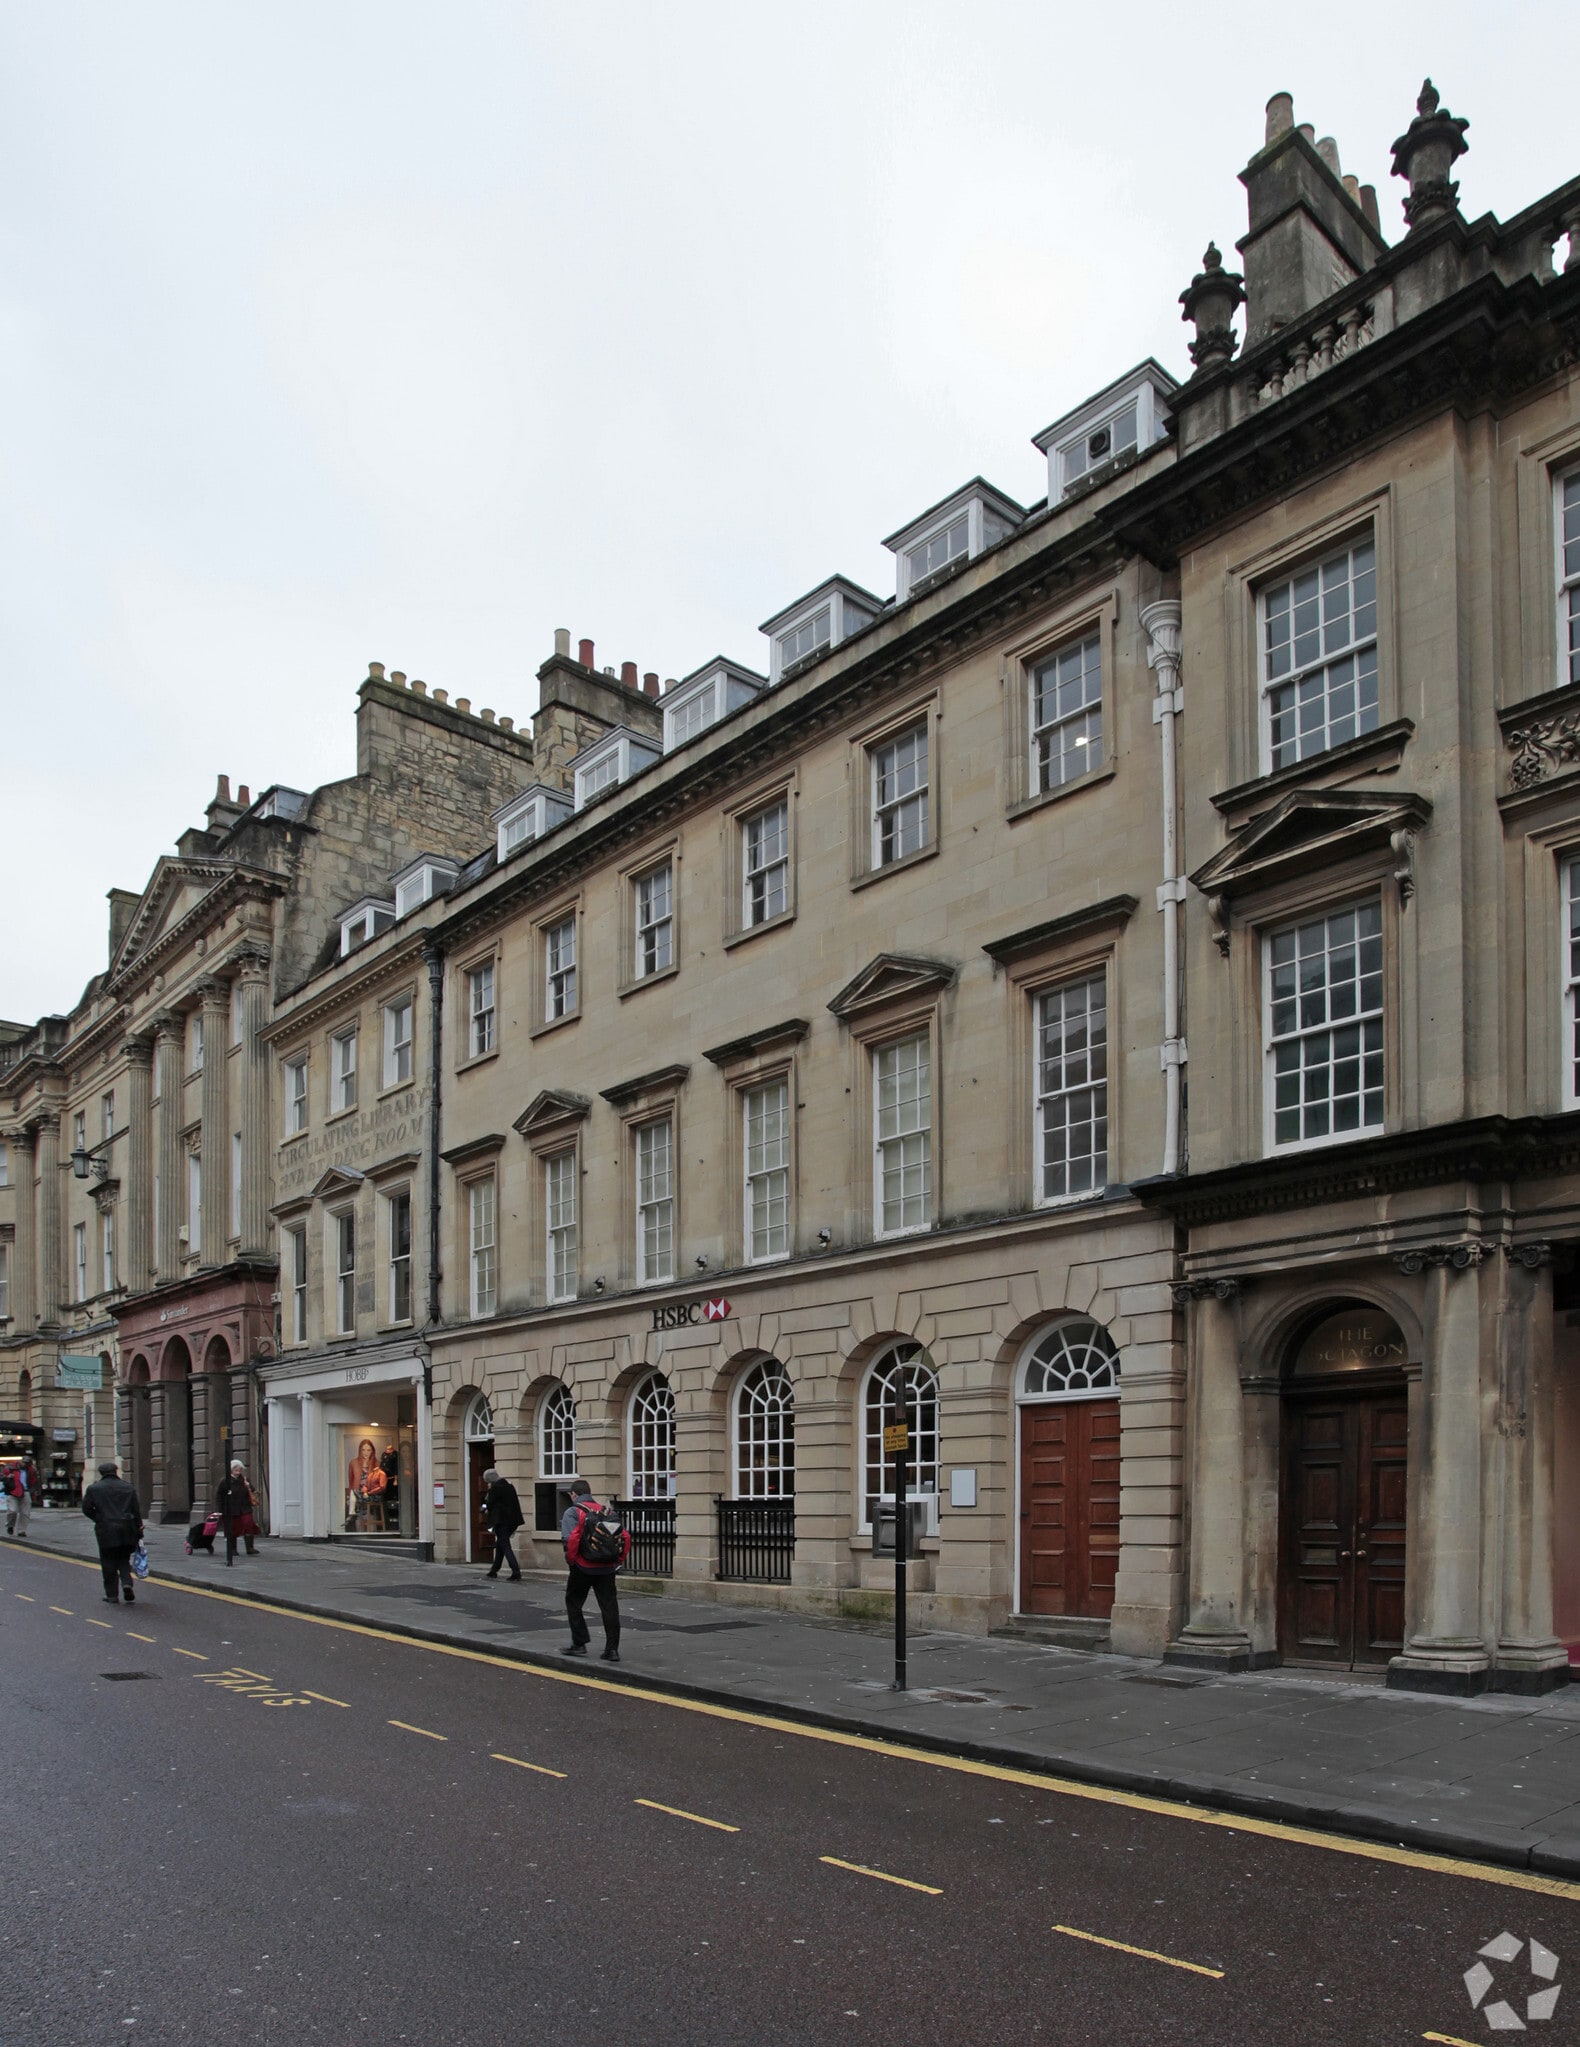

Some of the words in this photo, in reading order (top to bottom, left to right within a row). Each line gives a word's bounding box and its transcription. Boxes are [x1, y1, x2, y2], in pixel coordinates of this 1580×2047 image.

[277, 1117, 359, 1170] CIRCULATING
[361, 1088, 426, 1134] LIBRARY
[652, 1302, 701, 1329] HSBC
[1313, 1343, 1404, 1361] CTAGON
[193, 1671, 311, 1706] TAXIS
